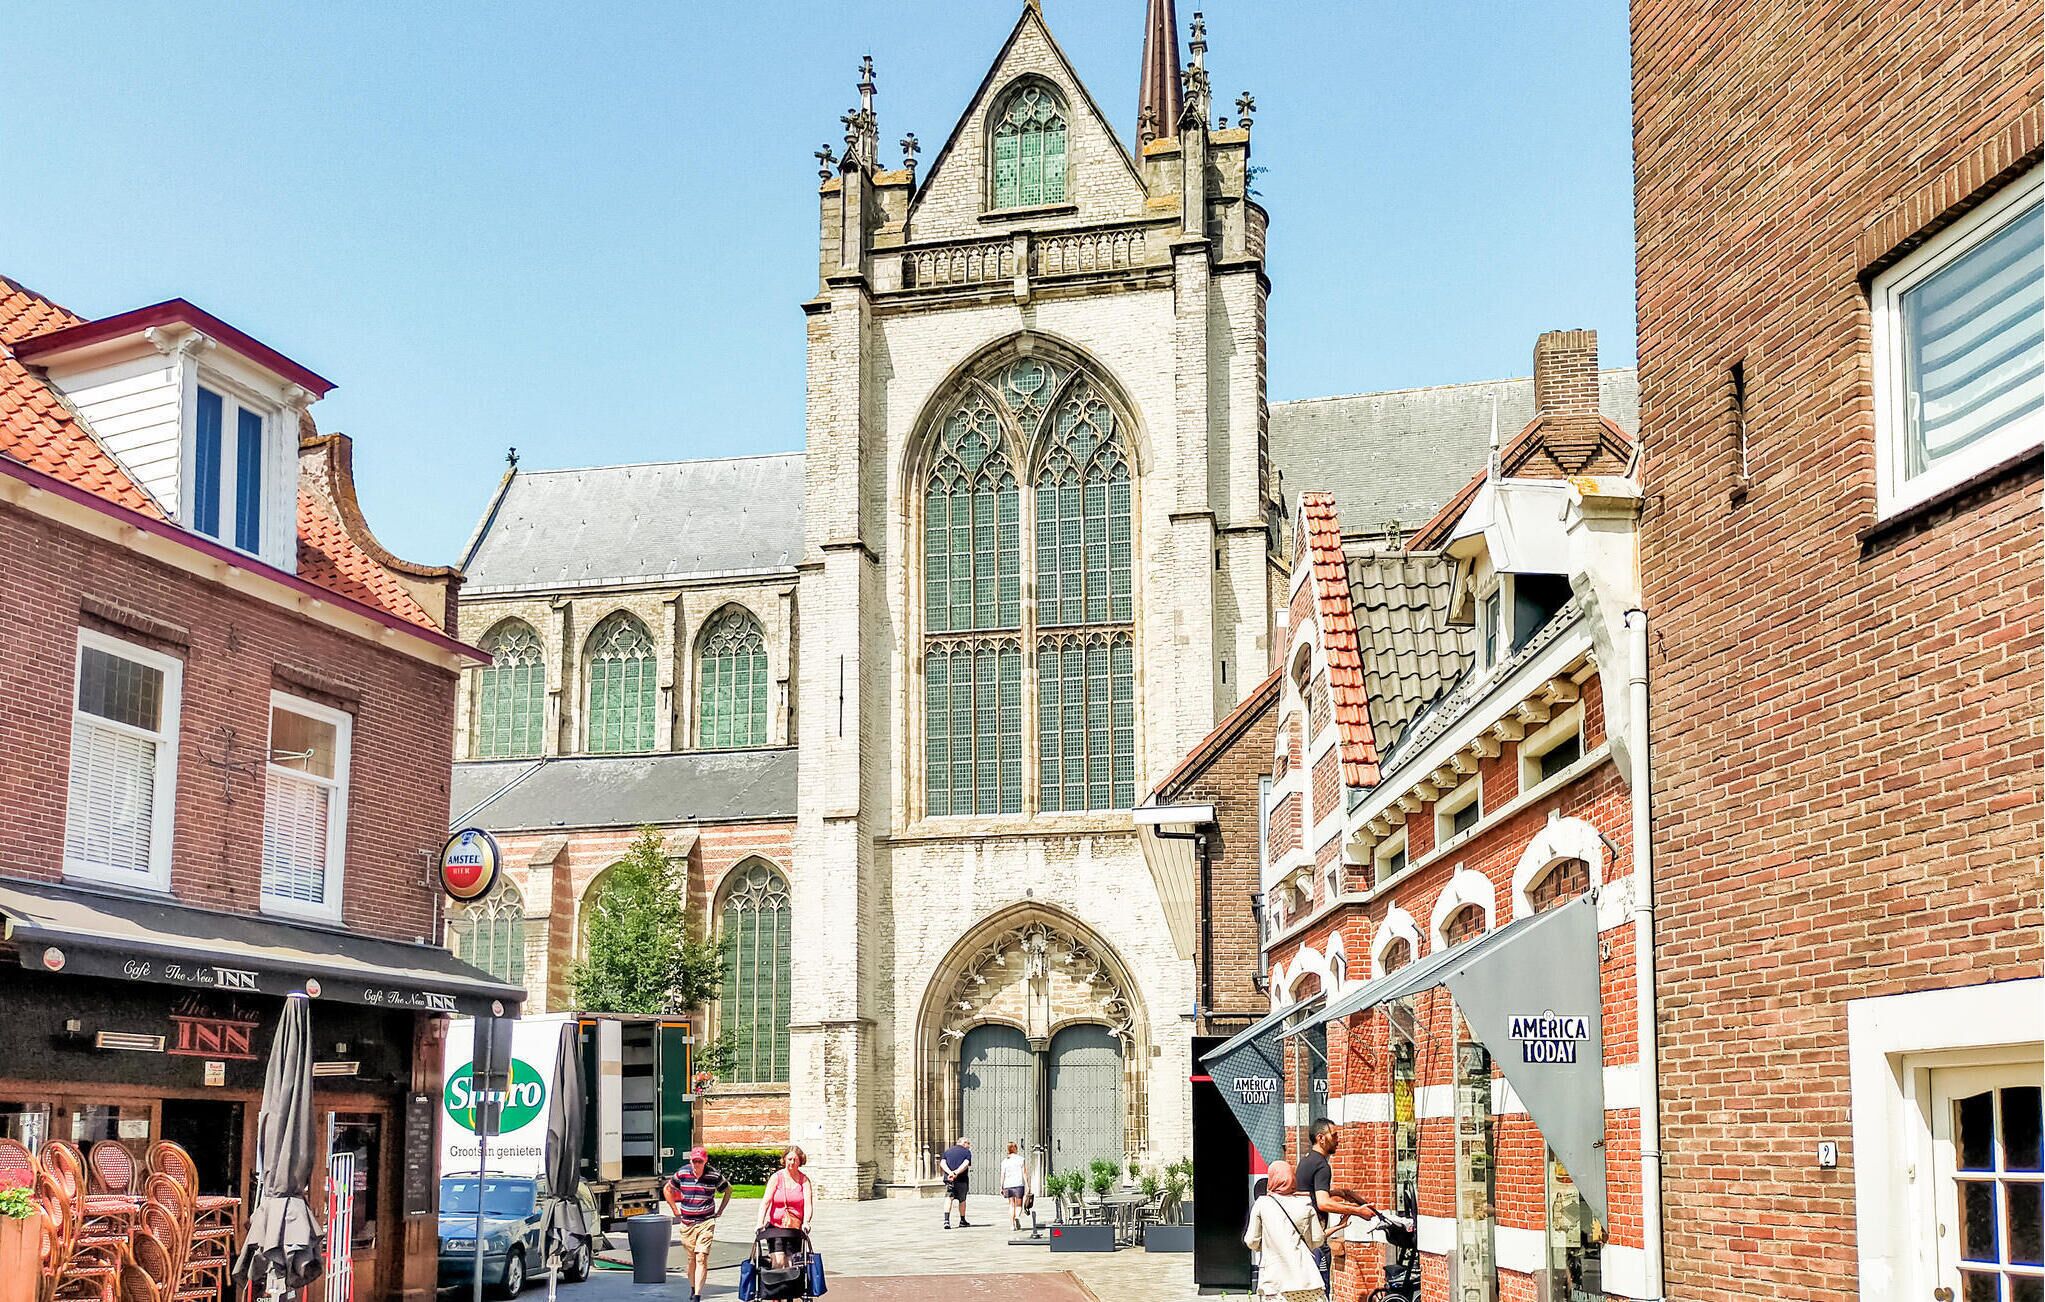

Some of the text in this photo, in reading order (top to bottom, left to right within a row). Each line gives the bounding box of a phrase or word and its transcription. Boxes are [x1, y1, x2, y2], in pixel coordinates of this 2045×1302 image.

[448, 855, 480, 864] AMSTEL
[453, 867, 470, 875] BIER
[165, 964, 186, 981] The
[187, 968, 214, 984] New
[213, 967, 259, 991] INN
[388, 991, 404, 1004] The
[405, 993, 425, 1006] New
[423, 992, 458, 1012] INN
[170, 1016, 258, 1059] INN
[1511, 1018, 1587, 1039] AMERICA
[1524, 1041, 1575, 1063] TODAY
[1235, 1079, 1275, 1091] AMERICA
[1242, 1092, 1269, 1104] TODAY
[450, 1145, 482, 1157] Groots
[497, 1145, 542, 1160] genieten
[1823, 1144, 1830, 1164] 2
